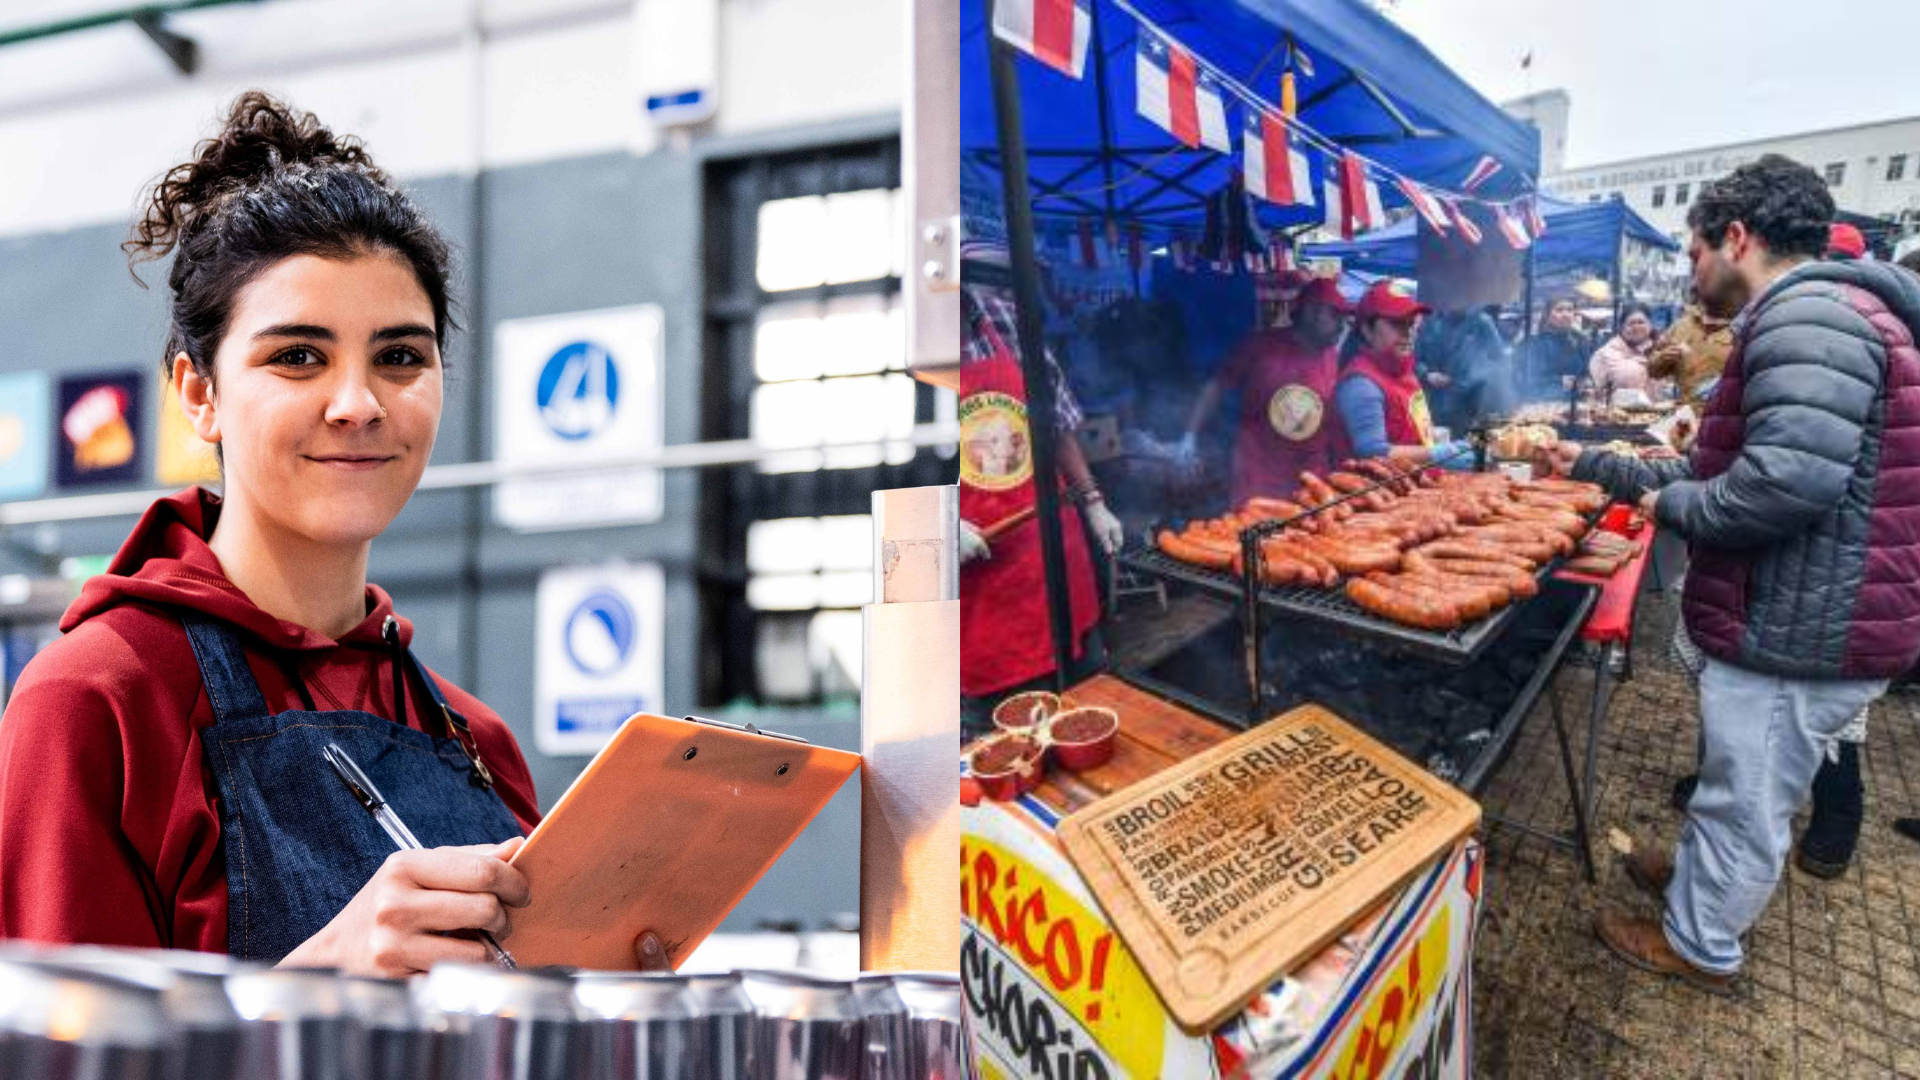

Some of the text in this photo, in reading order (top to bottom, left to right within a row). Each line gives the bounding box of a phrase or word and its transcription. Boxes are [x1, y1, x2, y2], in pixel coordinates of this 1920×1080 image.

[1220, 733, 1315, 781] GRILL
[1334, 749, 1425, 812] ROAST
[1115, 789, 1194, 836] BROIL
[1315, 787, 1383, 828] WELL
[1330, 808, 1413, 867] SEAR
[1178, 852, 1255, 908] SMOKE
[1195, 873, 1268, 927] MEDIUM
